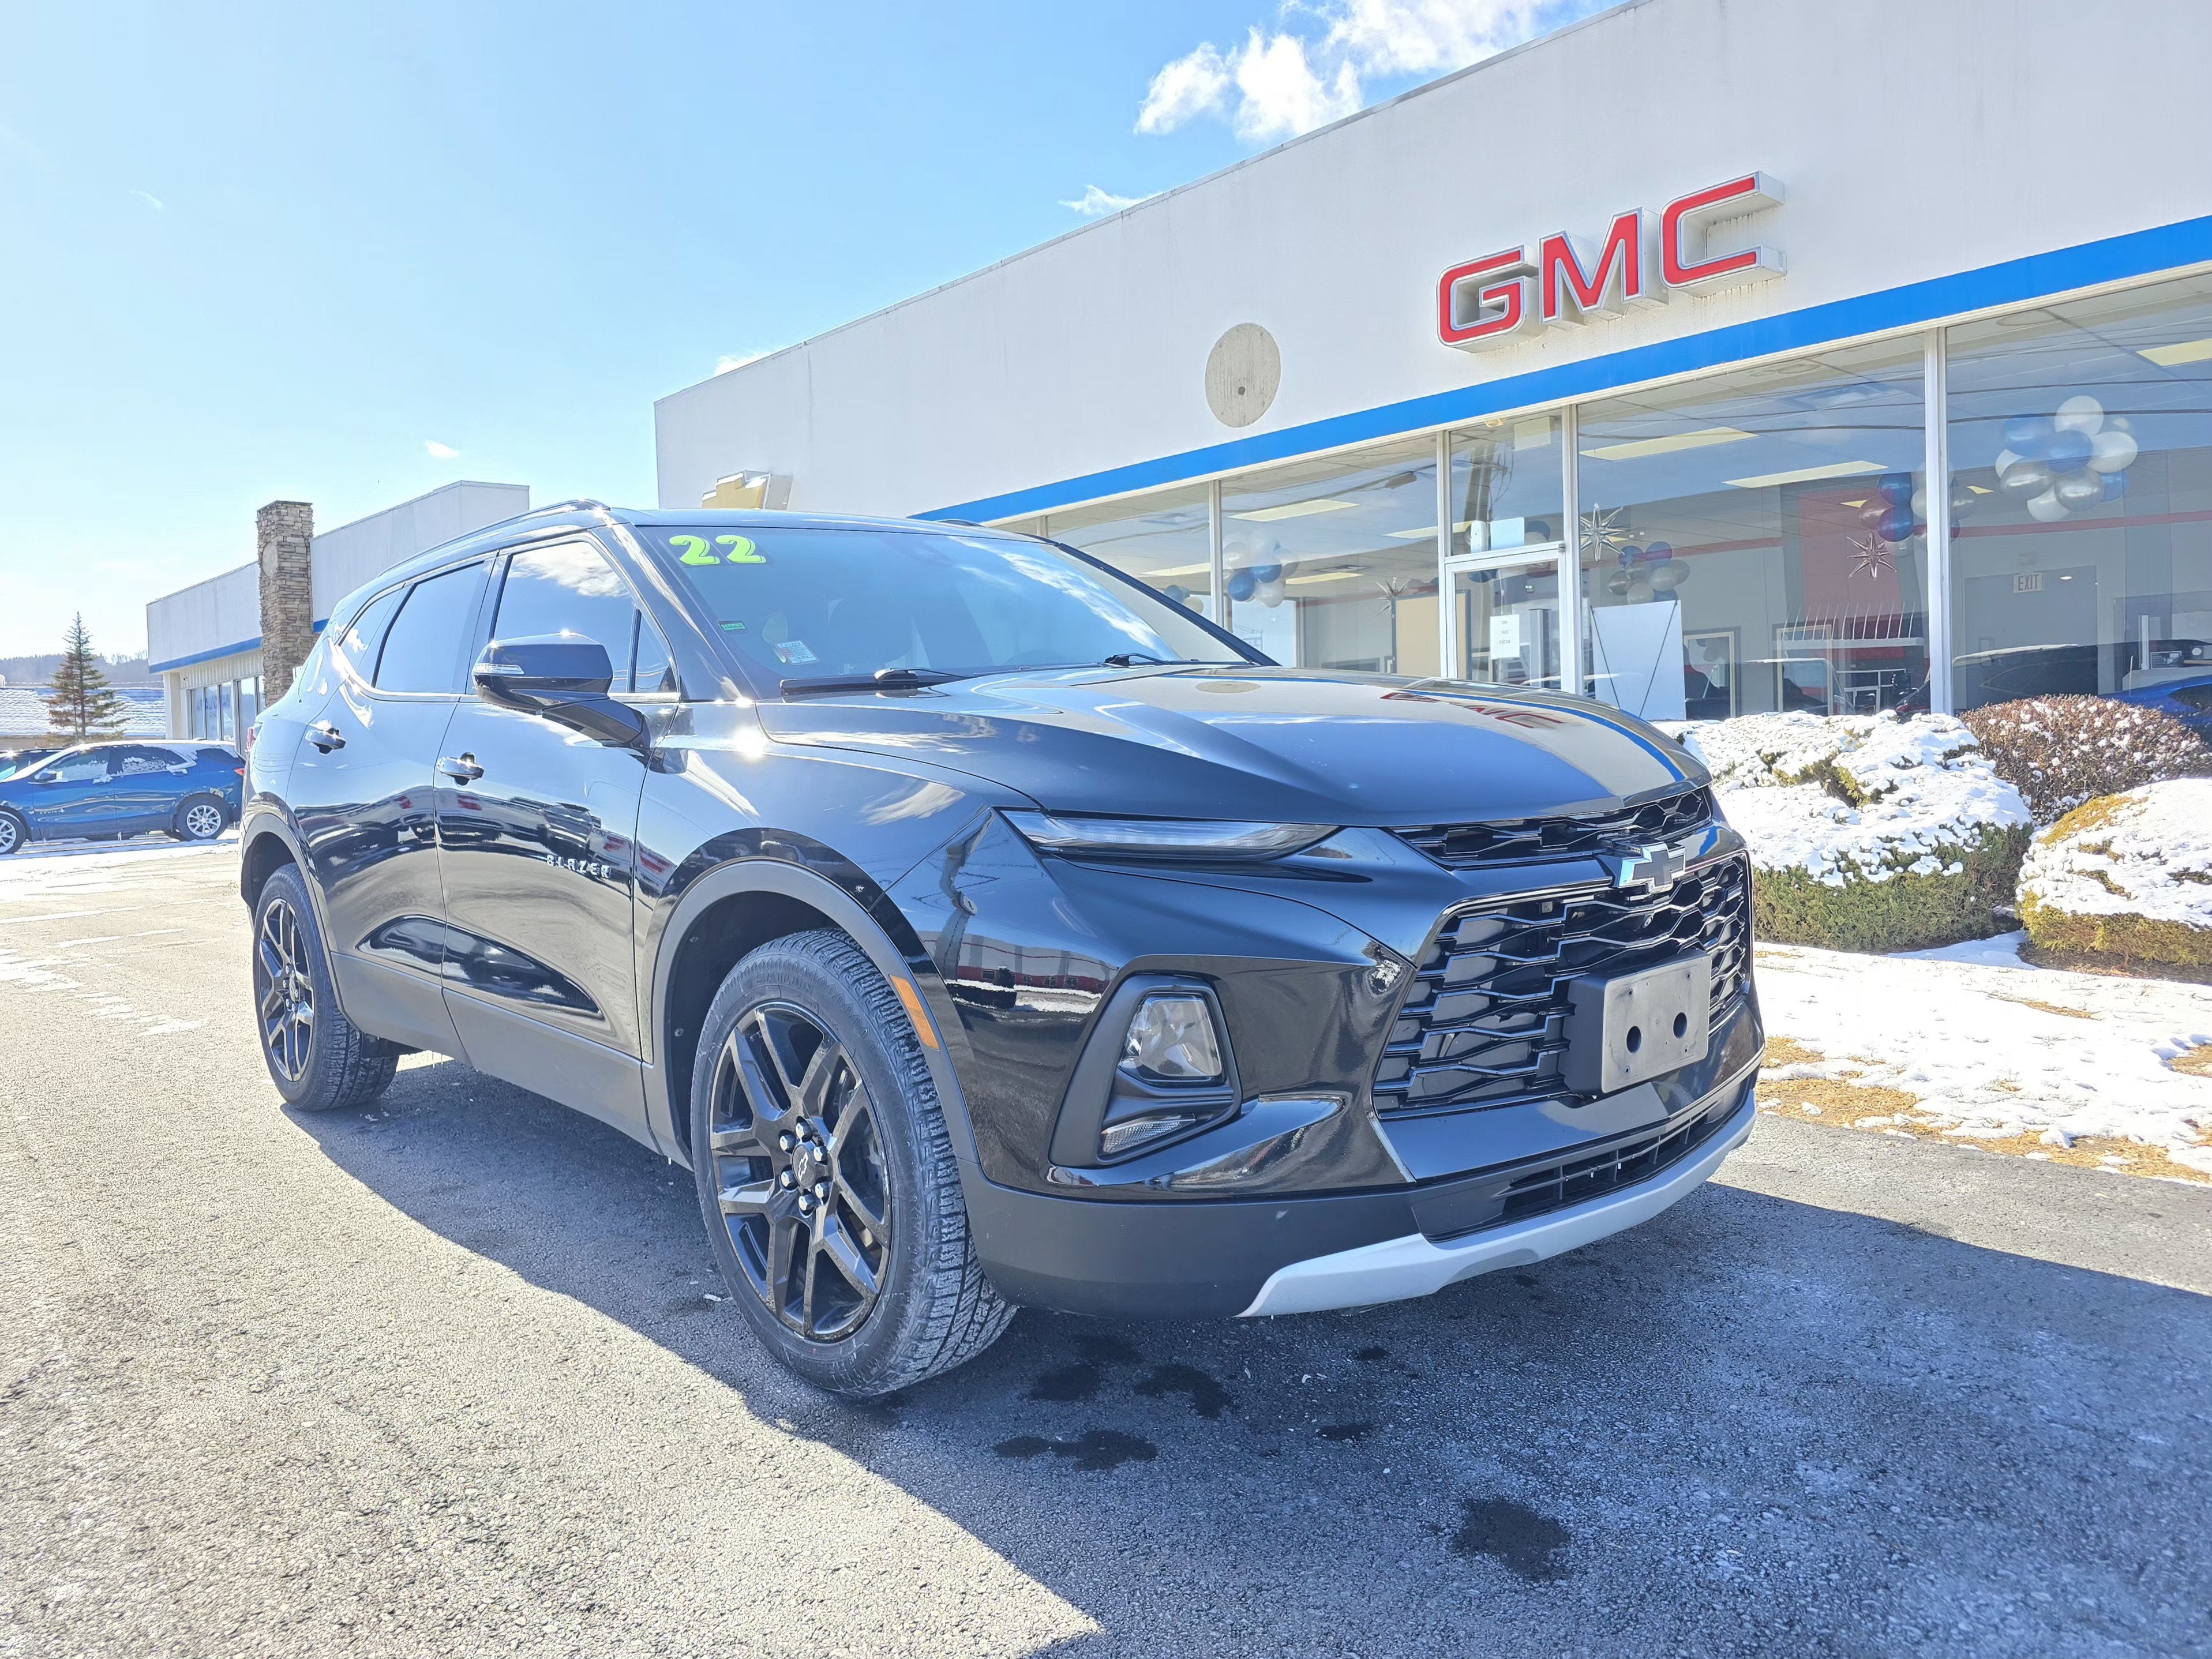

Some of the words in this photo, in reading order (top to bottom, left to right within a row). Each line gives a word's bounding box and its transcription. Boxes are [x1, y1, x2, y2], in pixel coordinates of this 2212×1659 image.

[1436, 171, 1764, 347] GMC
[669, 535, 766, 565] 22
[2018, 574, 2039, 591] EXIT
[546, 854, 612, 879] BLAZER
